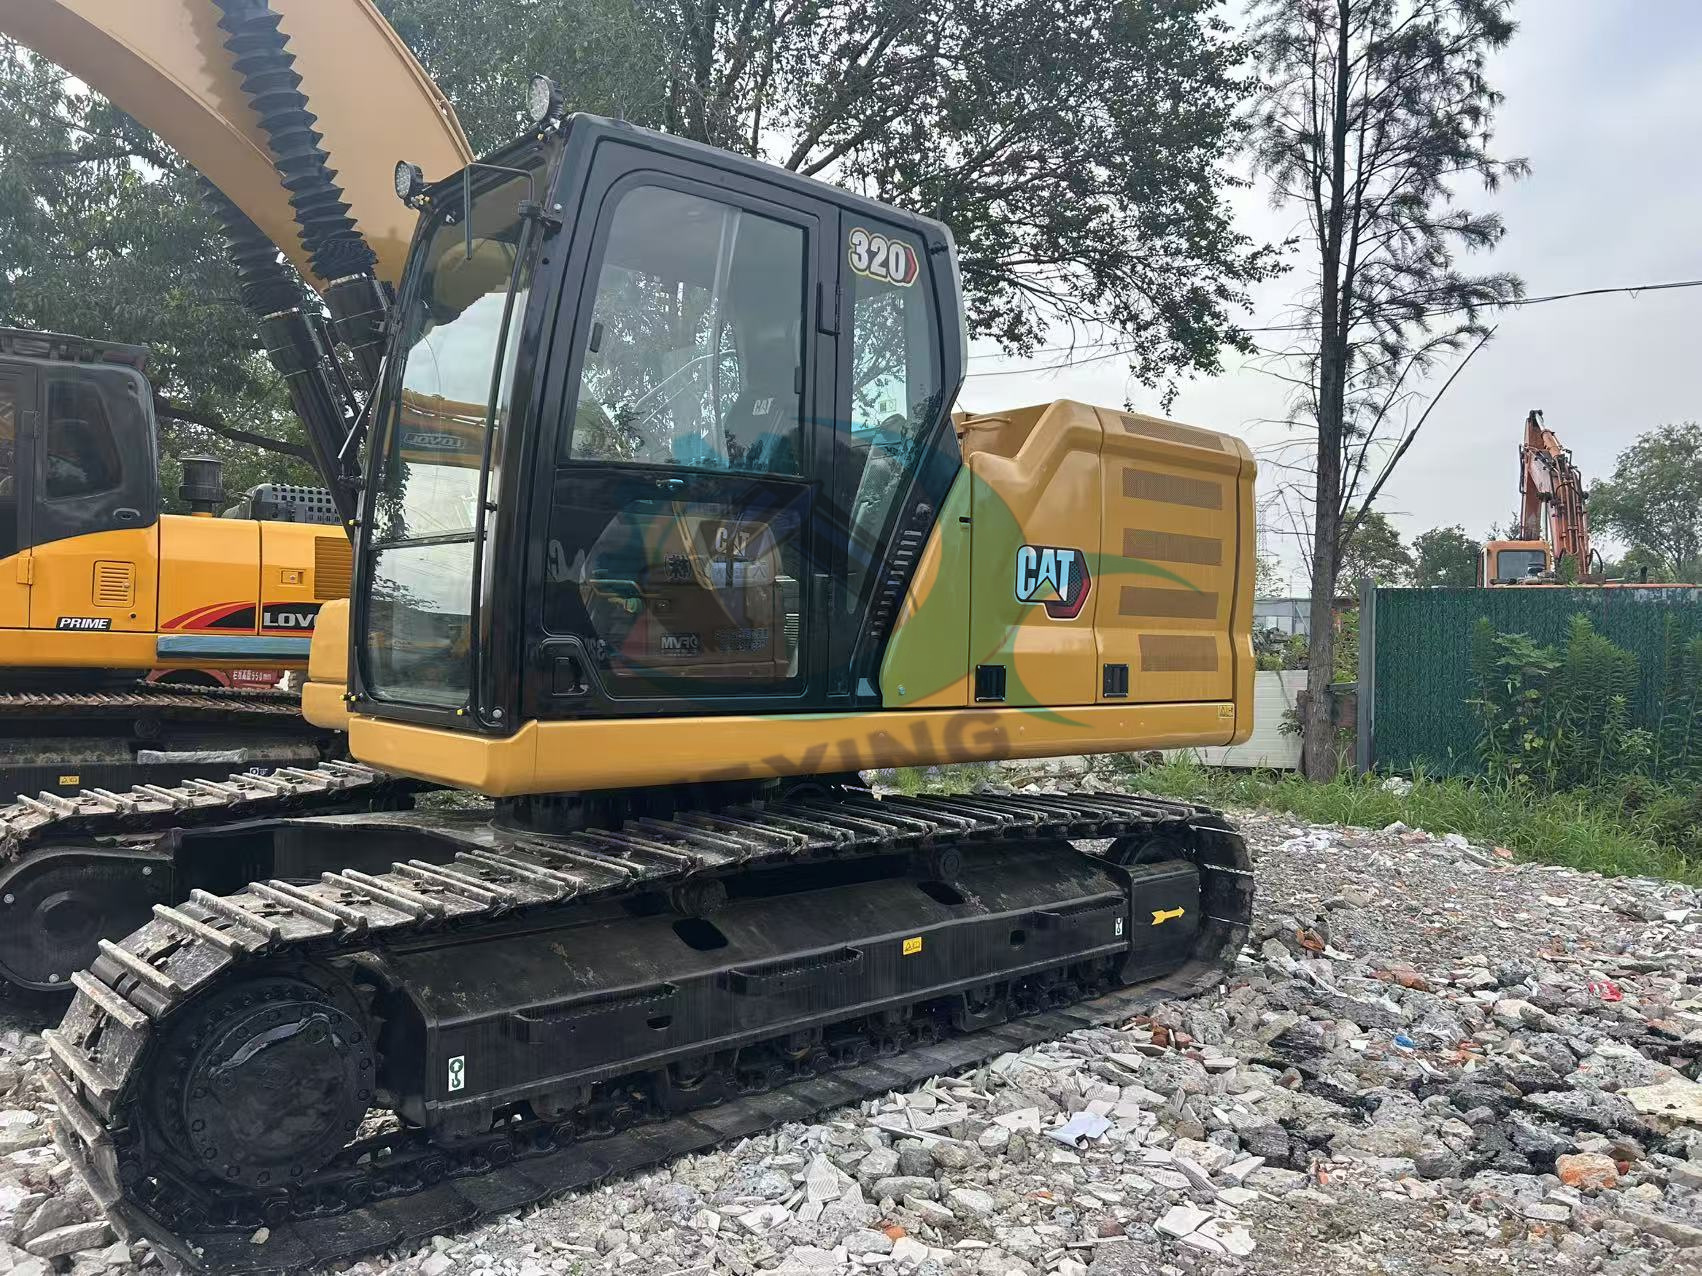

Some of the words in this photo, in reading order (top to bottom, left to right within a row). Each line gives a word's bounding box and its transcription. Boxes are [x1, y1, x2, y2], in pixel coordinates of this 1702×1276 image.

[849, 229, 907, 282] 320
[752, 397, 775, 416] CAT
[1016, 546, 1075, 602] CAT
[59, 617, 109, 629] PRIME
[263, 612, 317, 627] LOV
